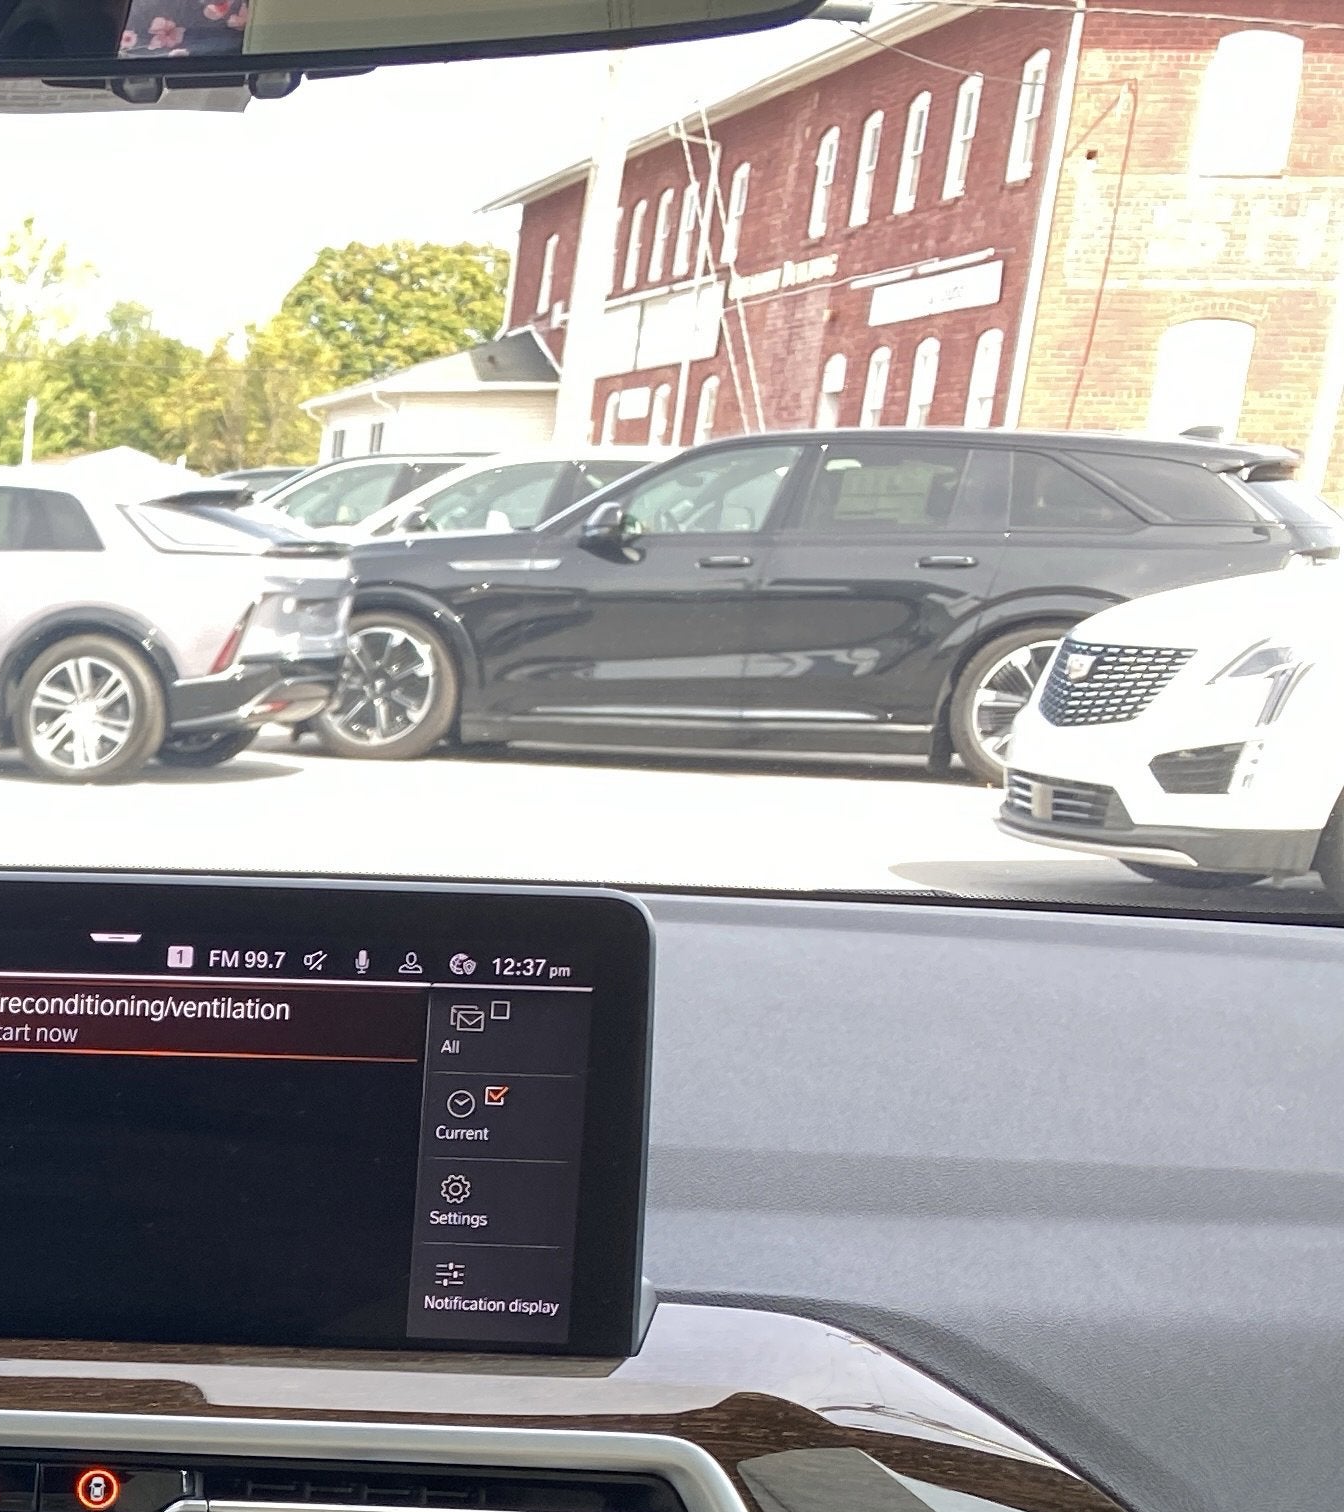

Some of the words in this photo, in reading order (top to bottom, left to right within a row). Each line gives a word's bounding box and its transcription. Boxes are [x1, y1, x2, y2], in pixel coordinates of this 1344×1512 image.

[208, 950, 239, 969] FM
[243, 950, 287, 970] 99.7
[492, 957, 547, 977] 12:37
[548, 965, 572, 980] pm
[35, 1025, 80, 1044] now
[440, 1039, 461, 1055] All
[434, 1124, 490, 1142] Current
[428, 1210, 489, 1230] Settings
[423, 1294, 506, 1314] Notification
[507, 1297, 560, 1317] display
